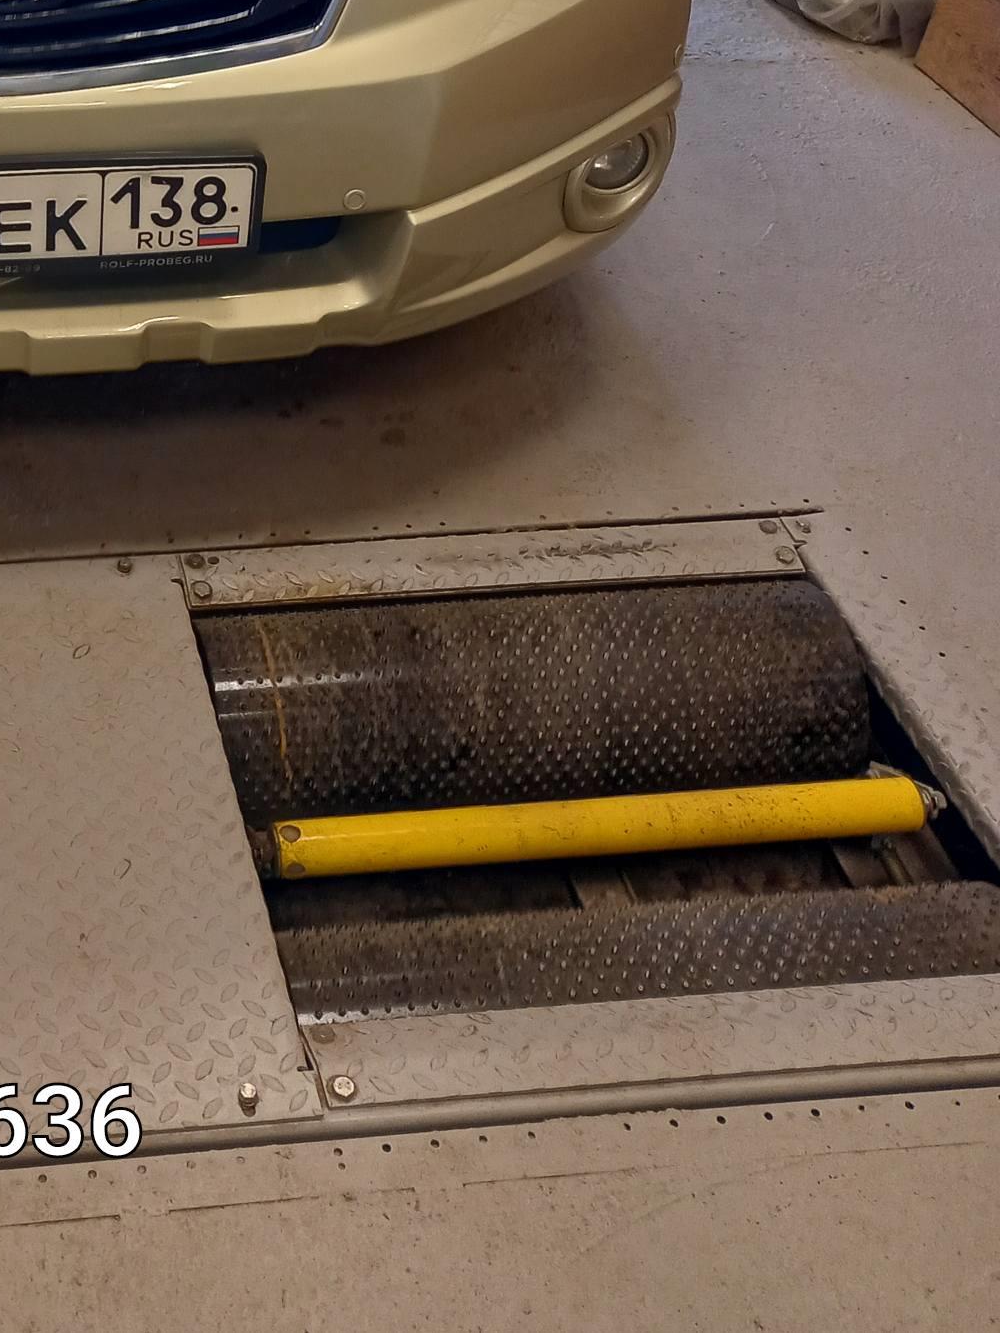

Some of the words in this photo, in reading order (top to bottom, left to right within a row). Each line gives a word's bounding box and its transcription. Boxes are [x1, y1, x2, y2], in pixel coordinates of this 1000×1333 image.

[110, 176, 227, 229] 138
[137, 229, 194, 250] RUS
[99, 254, 213, 269] ROLF-PROBEG.RU
